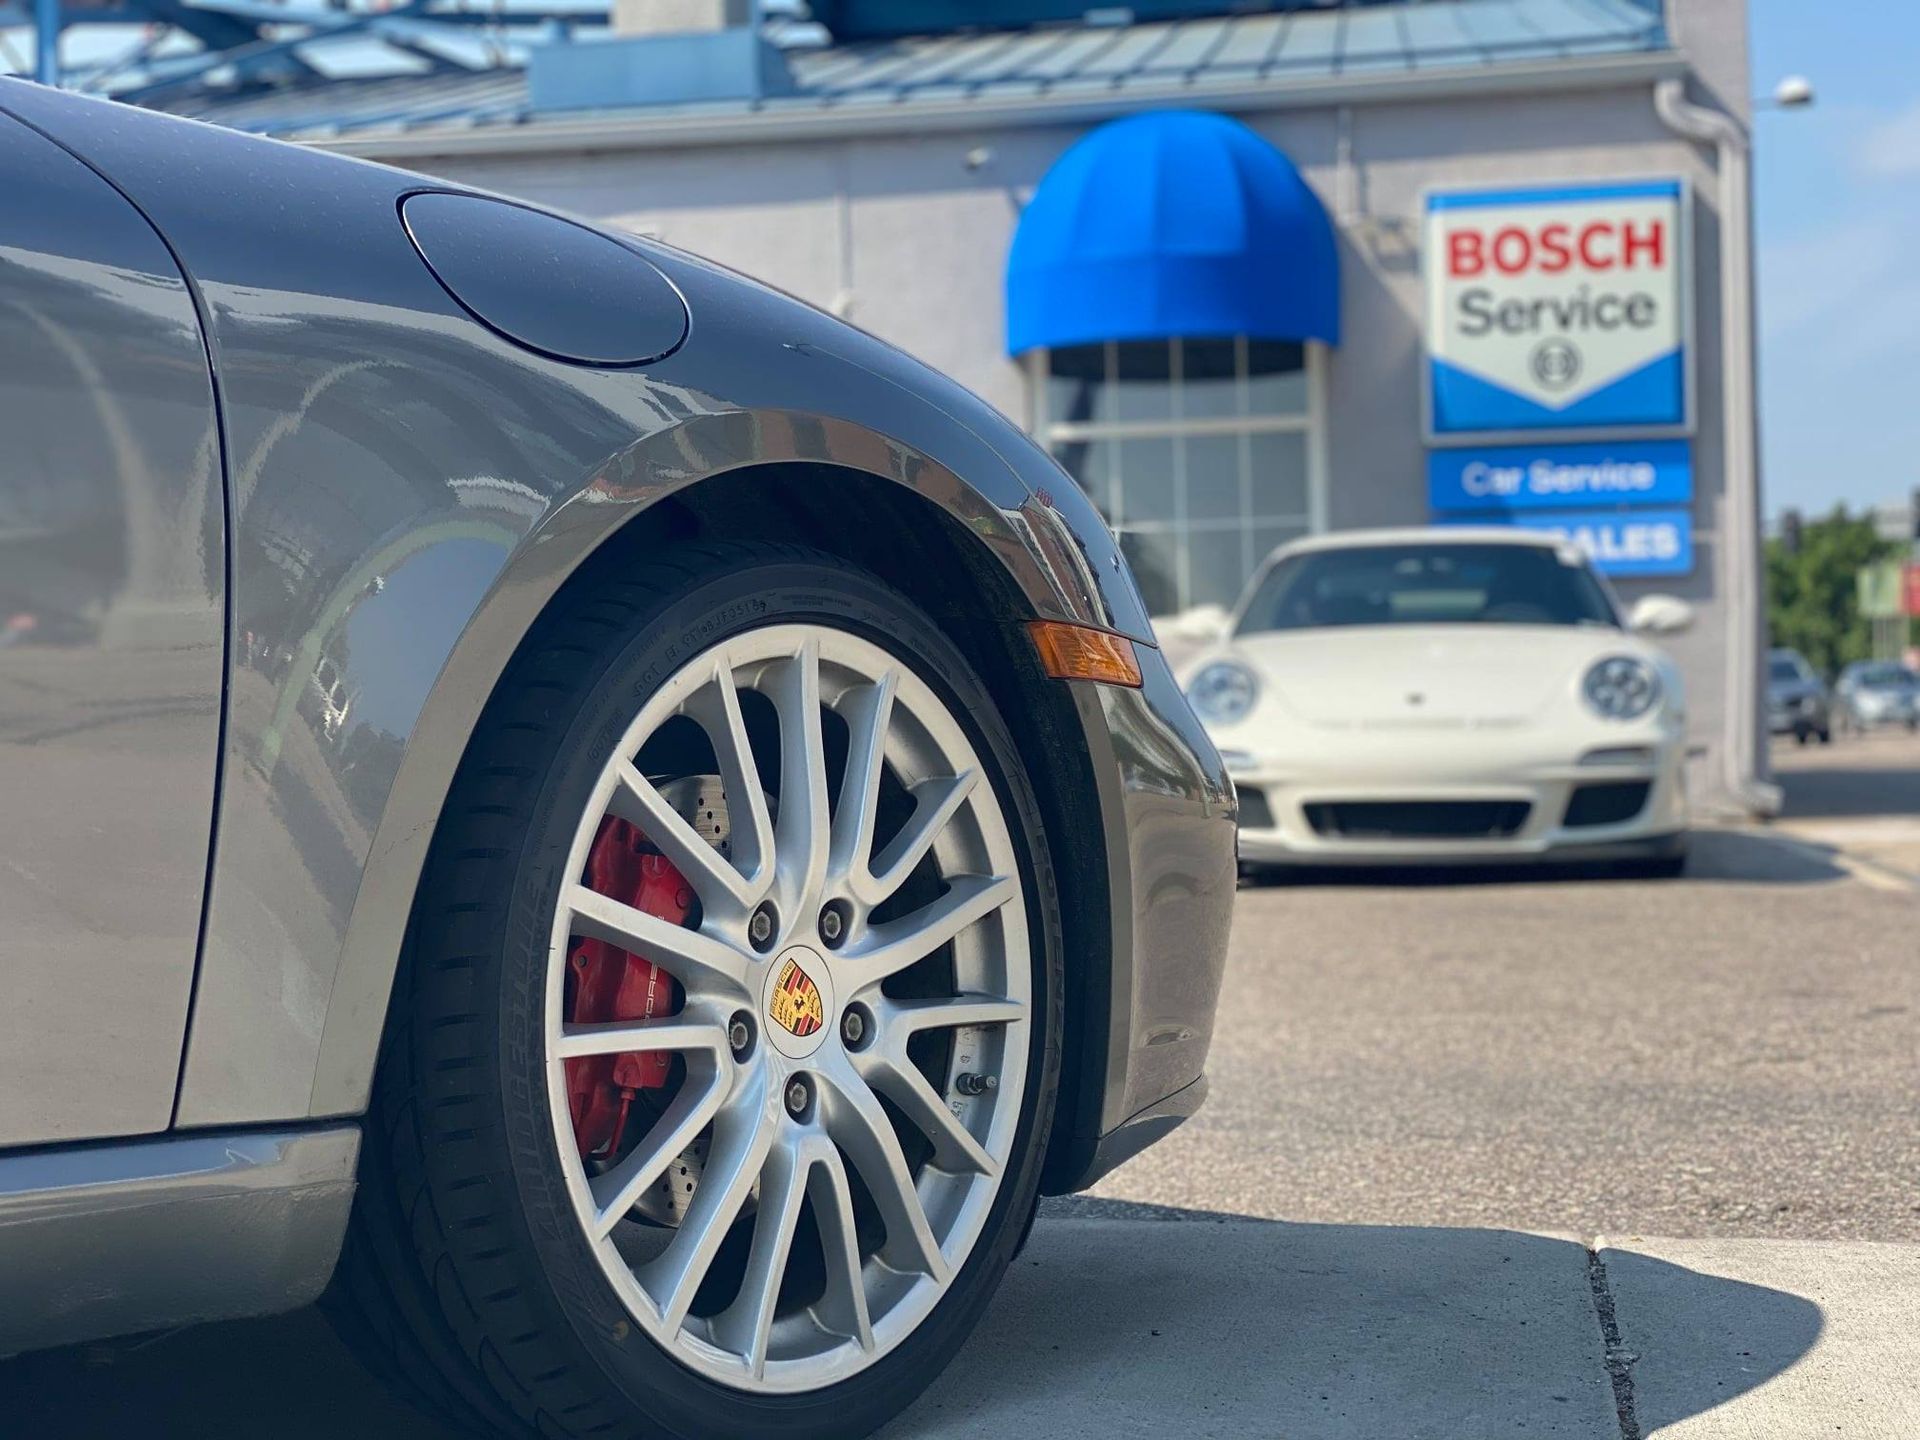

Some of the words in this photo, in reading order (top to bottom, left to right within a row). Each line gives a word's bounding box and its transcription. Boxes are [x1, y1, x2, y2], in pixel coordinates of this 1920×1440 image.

[1447, 221, 1665, 278] BOSCH
[1458, 284, 1656, 335] Service
[1462, 462, 1524, 496] Car
[1529, 459, 1656, 493] Service
[1556, 521, 1680, 560] ALES
